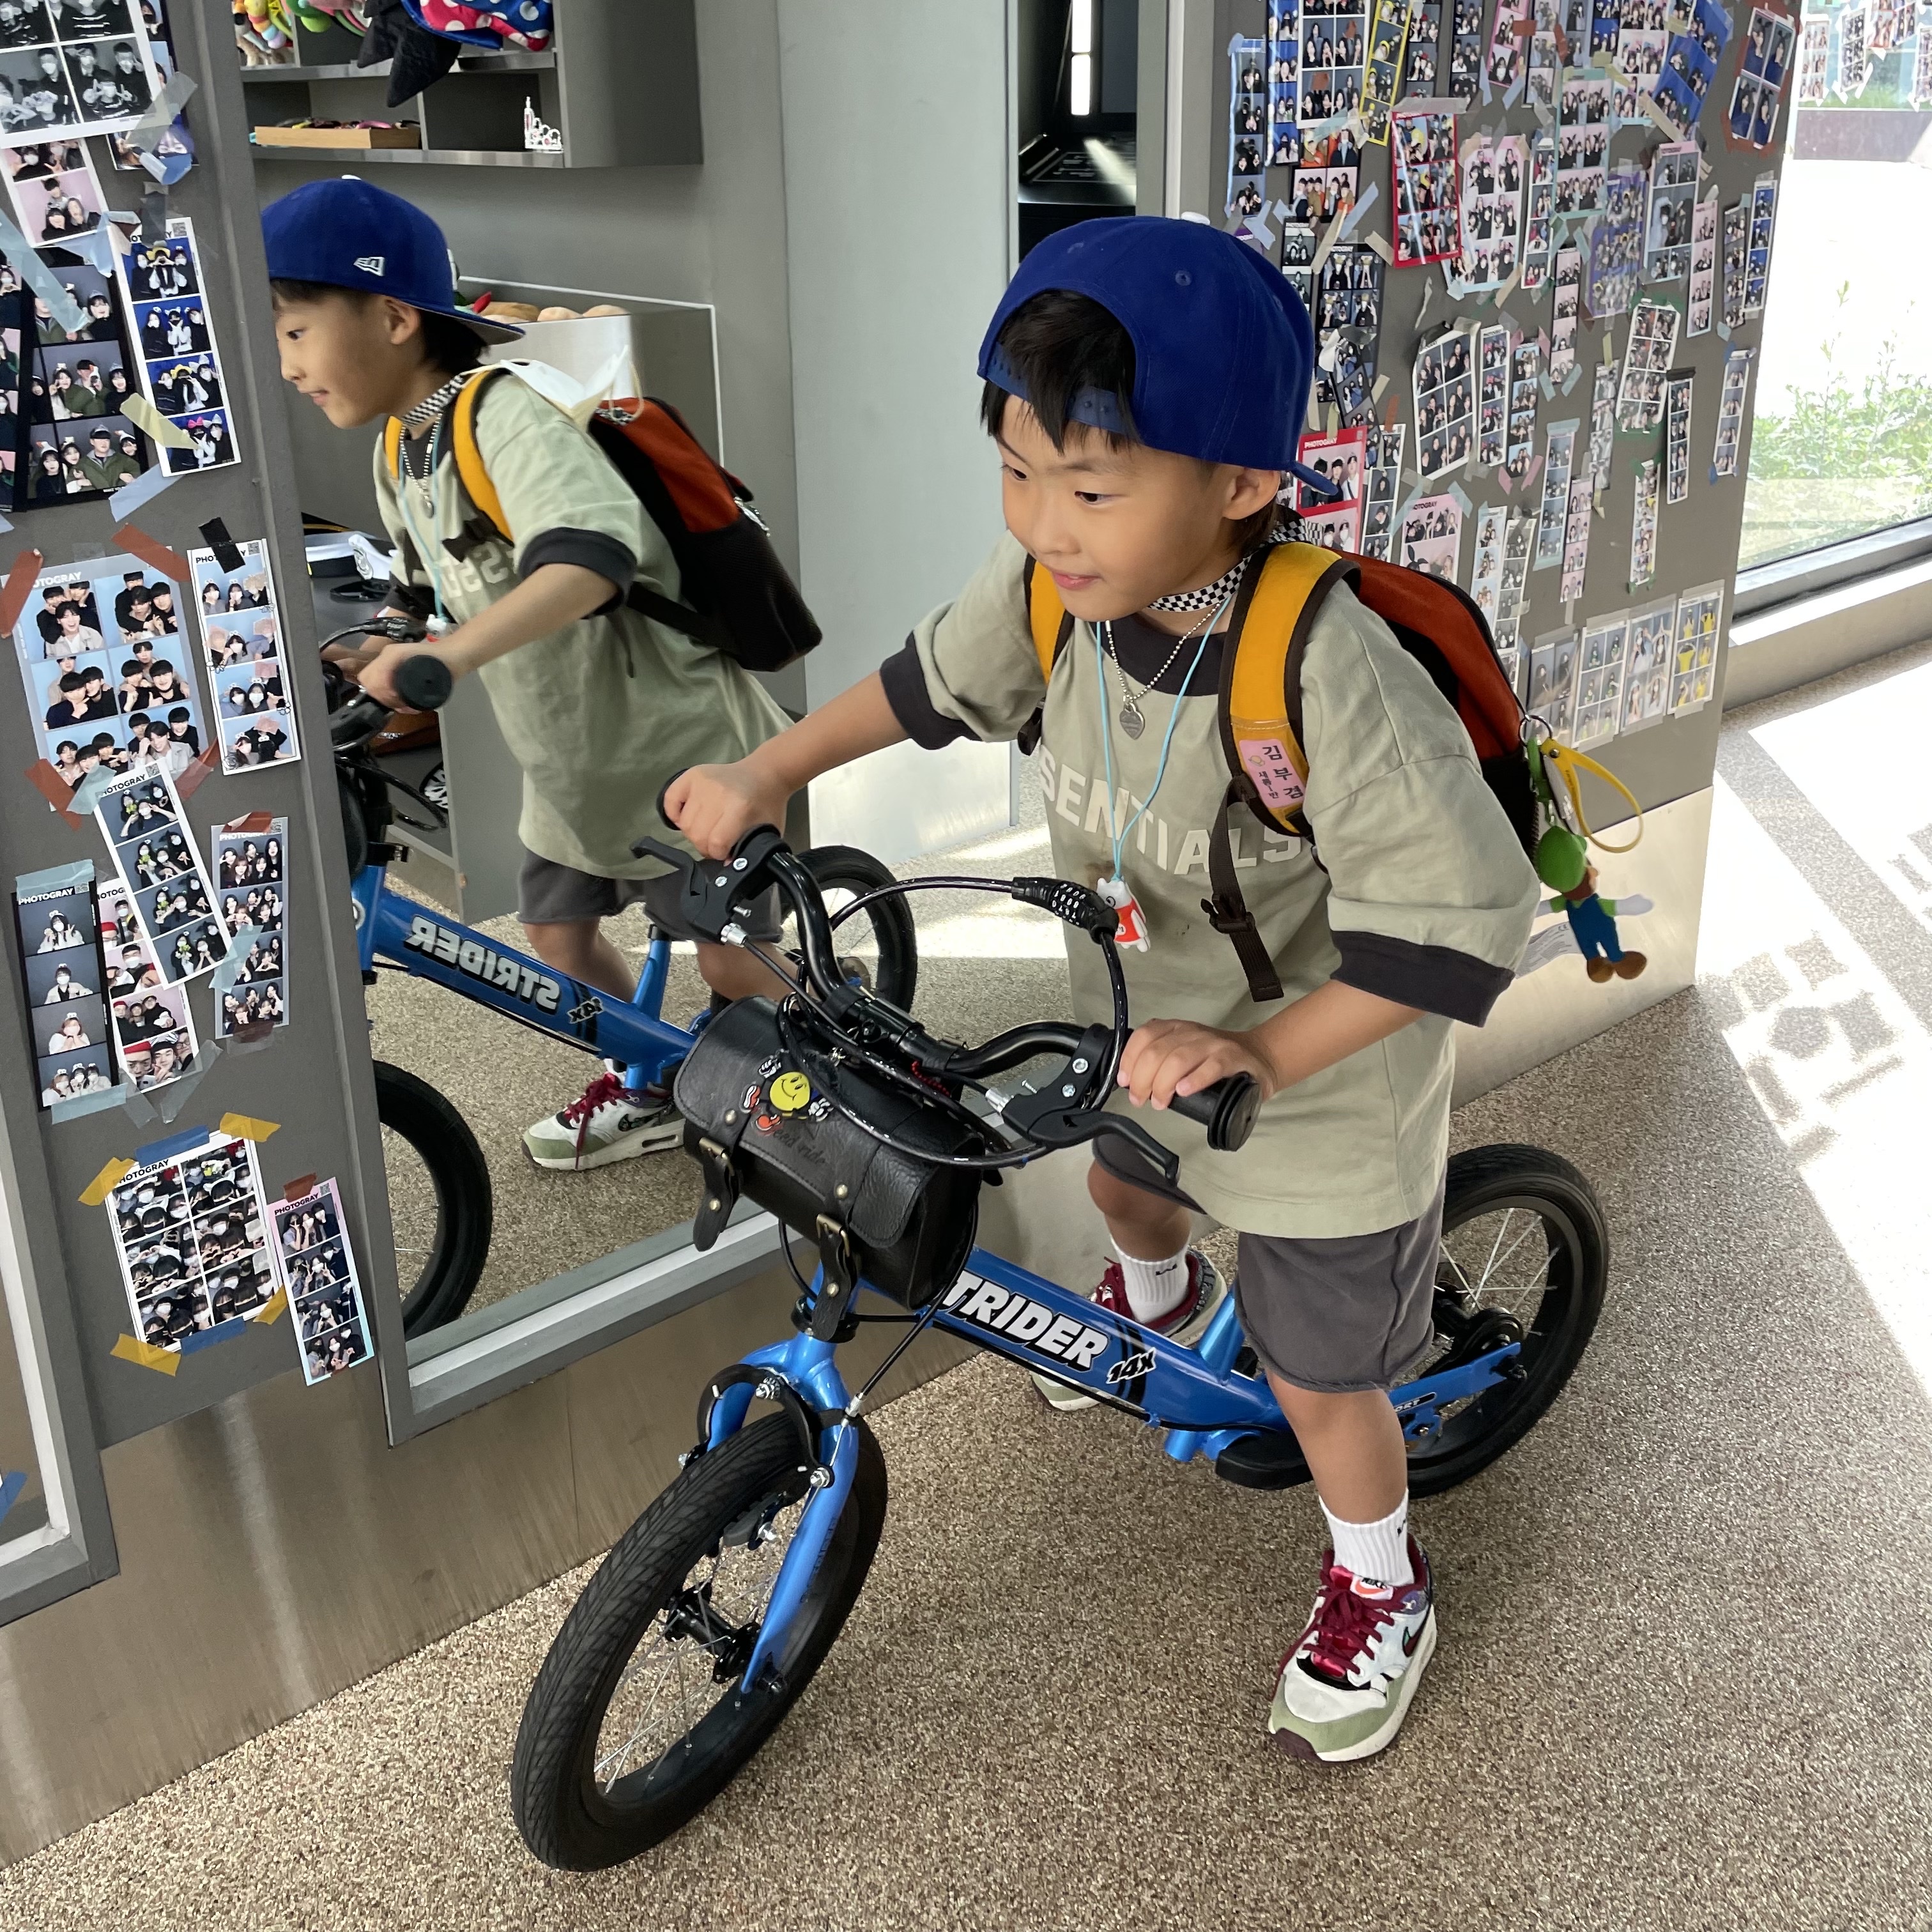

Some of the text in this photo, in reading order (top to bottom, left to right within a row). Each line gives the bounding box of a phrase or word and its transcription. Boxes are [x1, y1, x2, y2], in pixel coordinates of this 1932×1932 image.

[118, 1158, 169, 1184] HOTOGRAY
[274, 1192, 319, 1215] PHOTOGRAY
[942, 1268, 1157, 1384] TRIDER 14X
